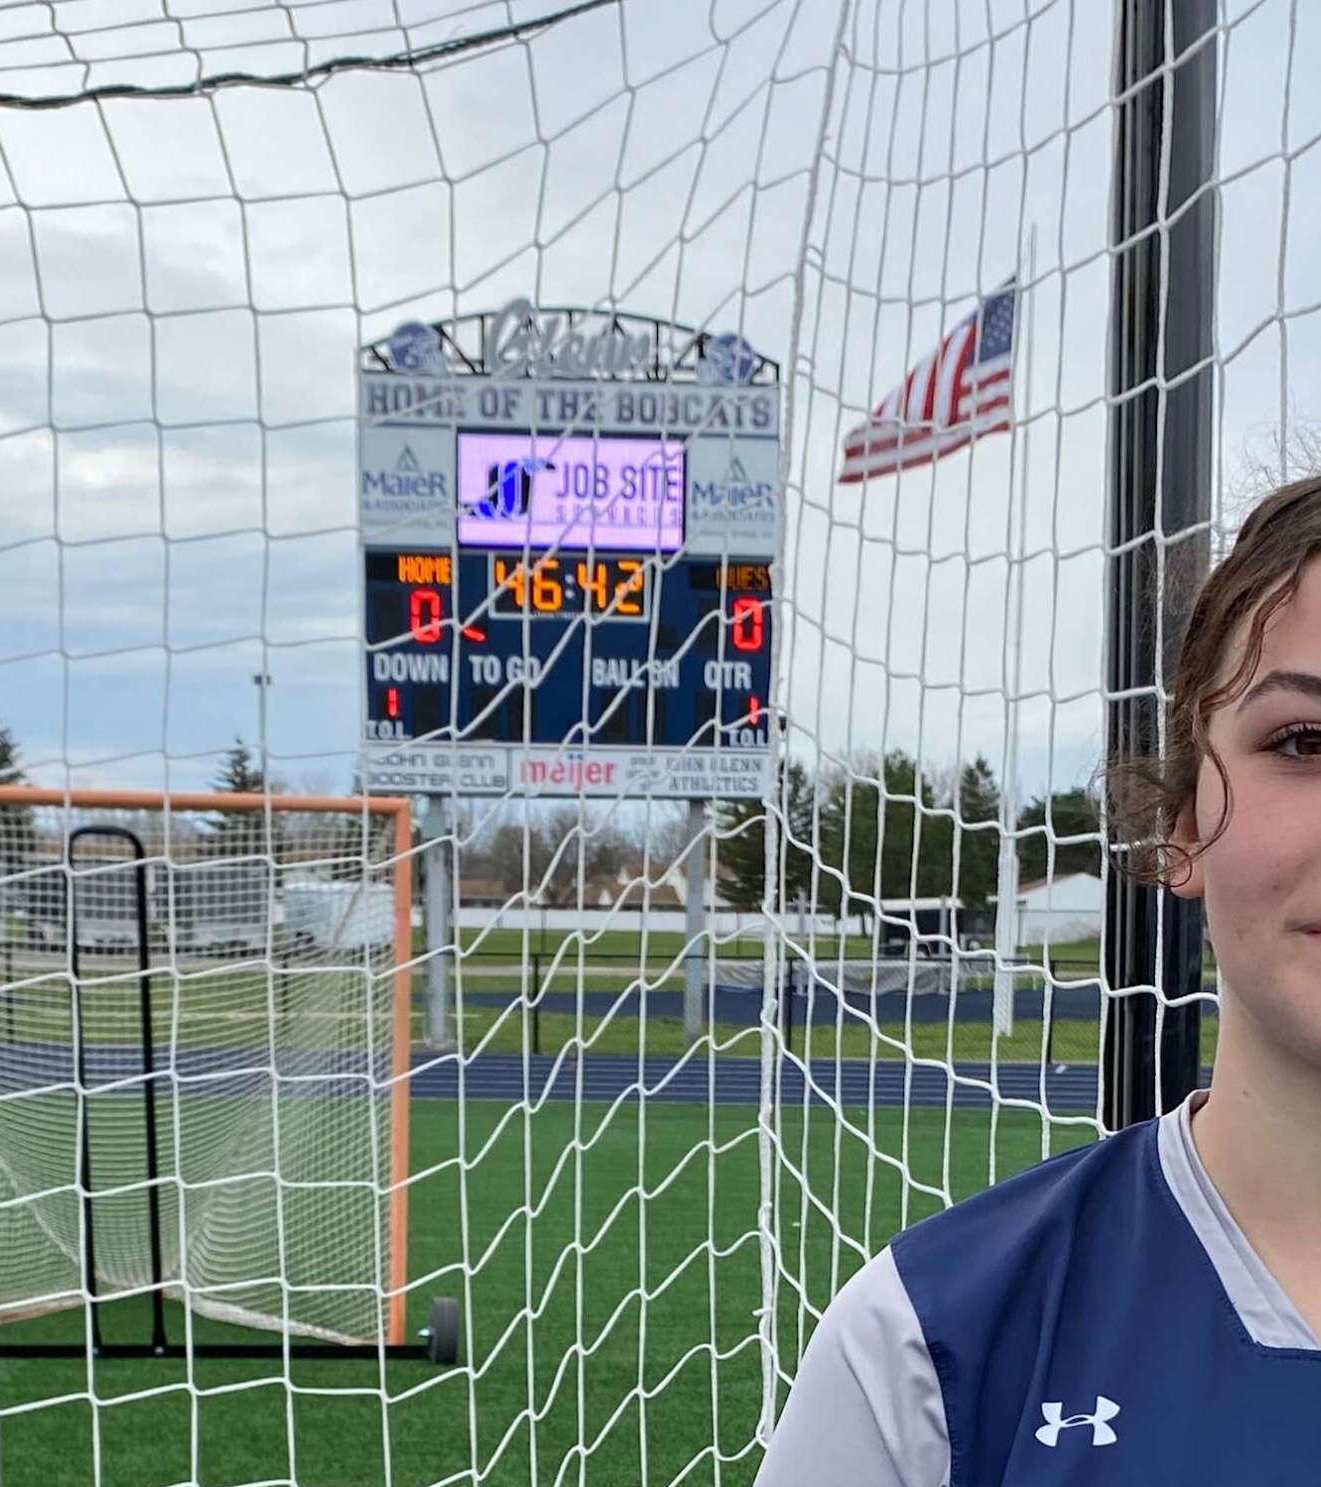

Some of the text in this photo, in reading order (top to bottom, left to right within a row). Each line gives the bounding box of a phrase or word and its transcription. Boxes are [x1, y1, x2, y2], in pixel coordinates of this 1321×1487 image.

[480, 385, 522, 420] OF
[617, 390, 771, 428] BOBCATS
[556, 462, 679, 502] JOB SITE
[398, 555, 453, 585] HOME
[494, 558, 644, 614] 46:42
[410, 589, 442, 643] 0
[733, 597, 764, 650] 0
[374, 653, 449, 682] DOWN
[468, 655, 541, 685] TO GO
[592, 658, 680, 688] BALL ON
[704, 661, 753, 690] QTR
[460, 774, 507, 788] CLUB
[521, 753, 616, 792] meijer
